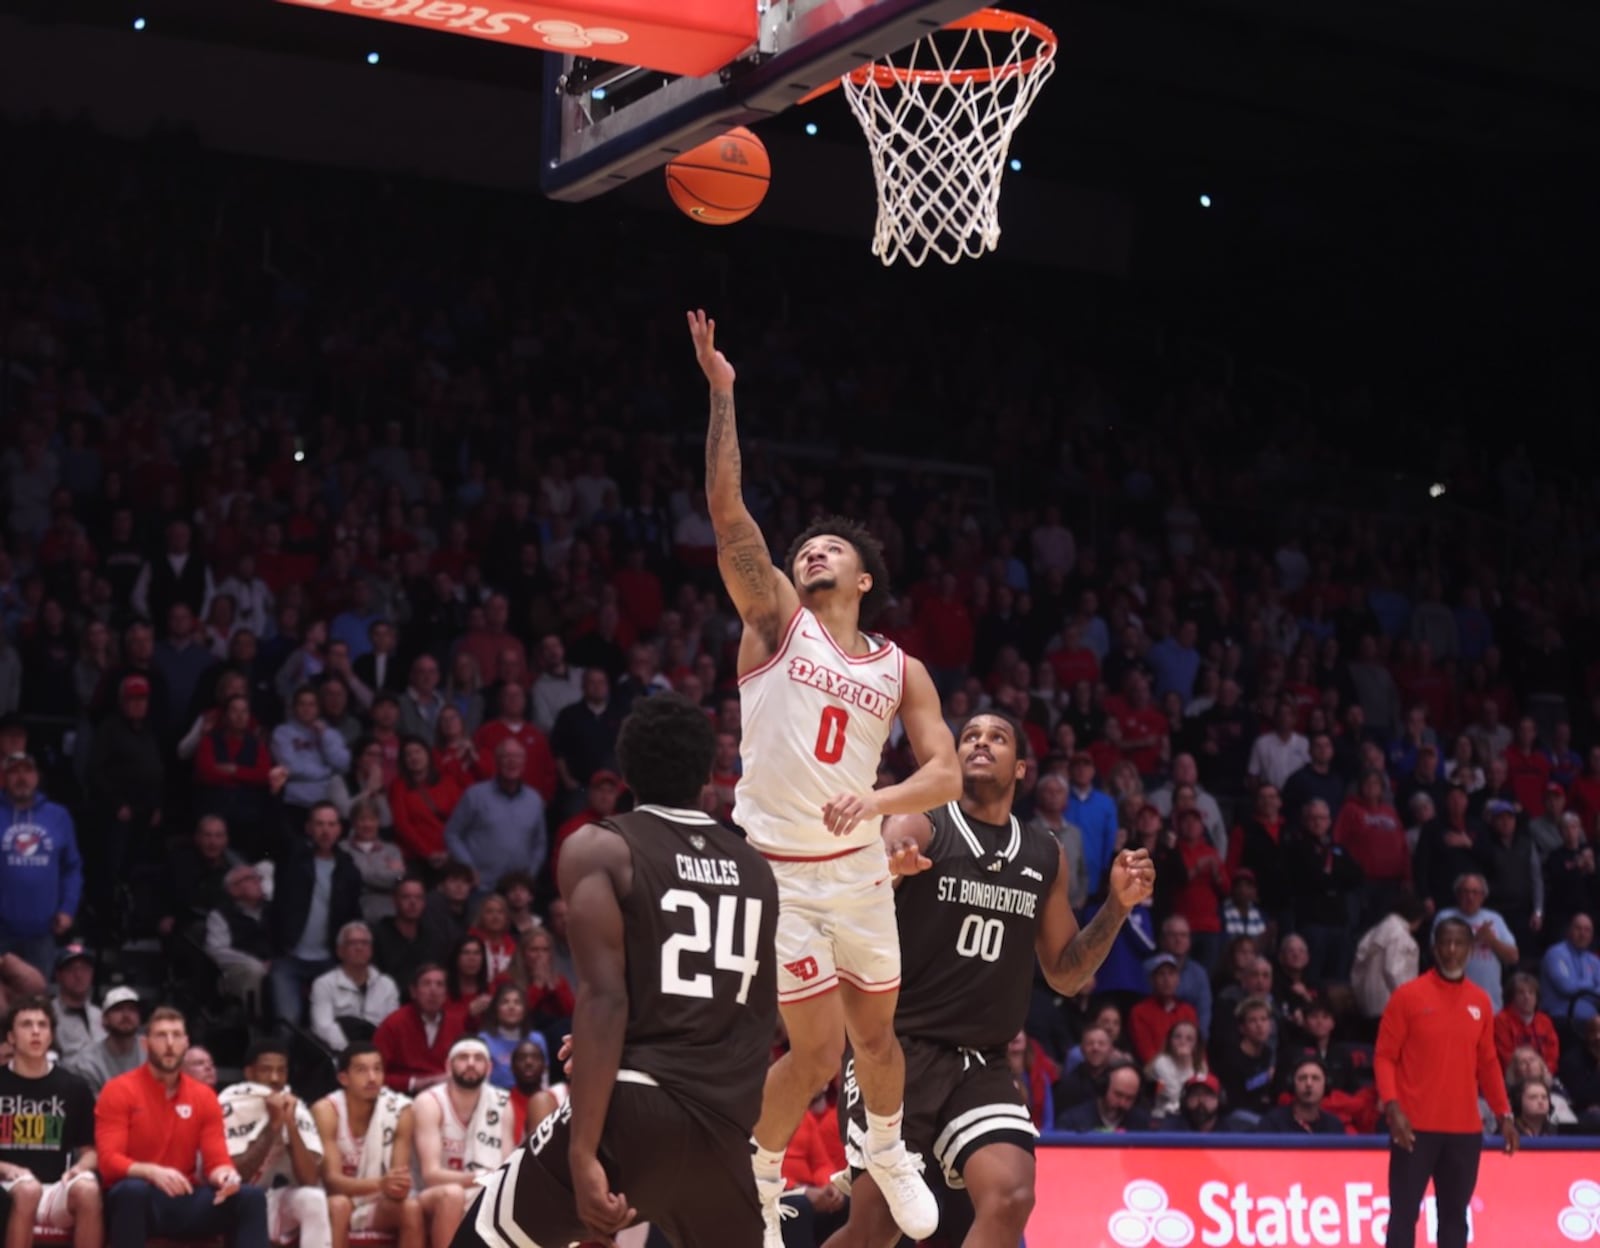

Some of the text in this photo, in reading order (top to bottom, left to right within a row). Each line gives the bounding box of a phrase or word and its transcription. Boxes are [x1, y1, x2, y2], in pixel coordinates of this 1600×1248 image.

[788, 656, 895, 721] DAYTON
[814, 705, 849, 764] 0
[675, 853, 740, 886] CHARLES
[937, 876, 1038, 919] ST. BONAVENTURE
[660, 888, 763, 1005] 24
[956, 914, 1005, 963] 00
[0, 1094, 66, 1117] Black
